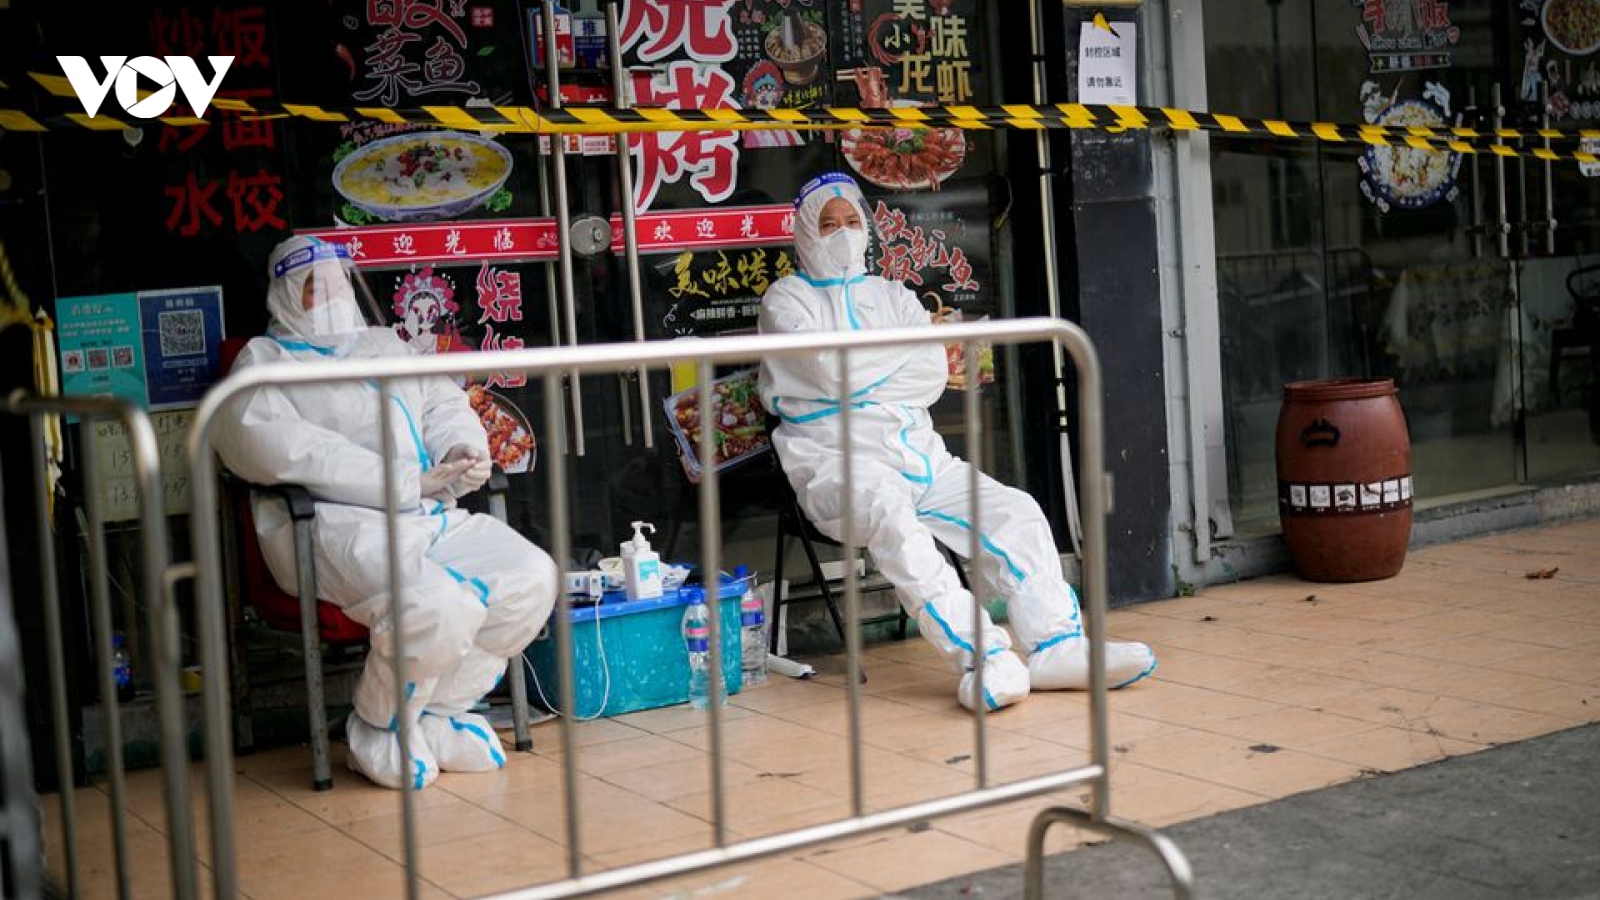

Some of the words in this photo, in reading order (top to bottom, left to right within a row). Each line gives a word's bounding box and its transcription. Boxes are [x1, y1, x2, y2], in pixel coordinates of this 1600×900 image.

[1084, 45, 1121, 59] 封控区域
[1086, 75, 1123, 89] 请勿靠近
[162, 168, 288, 237] 水饺
[346, 226, 515, 258] 欢迎光临
